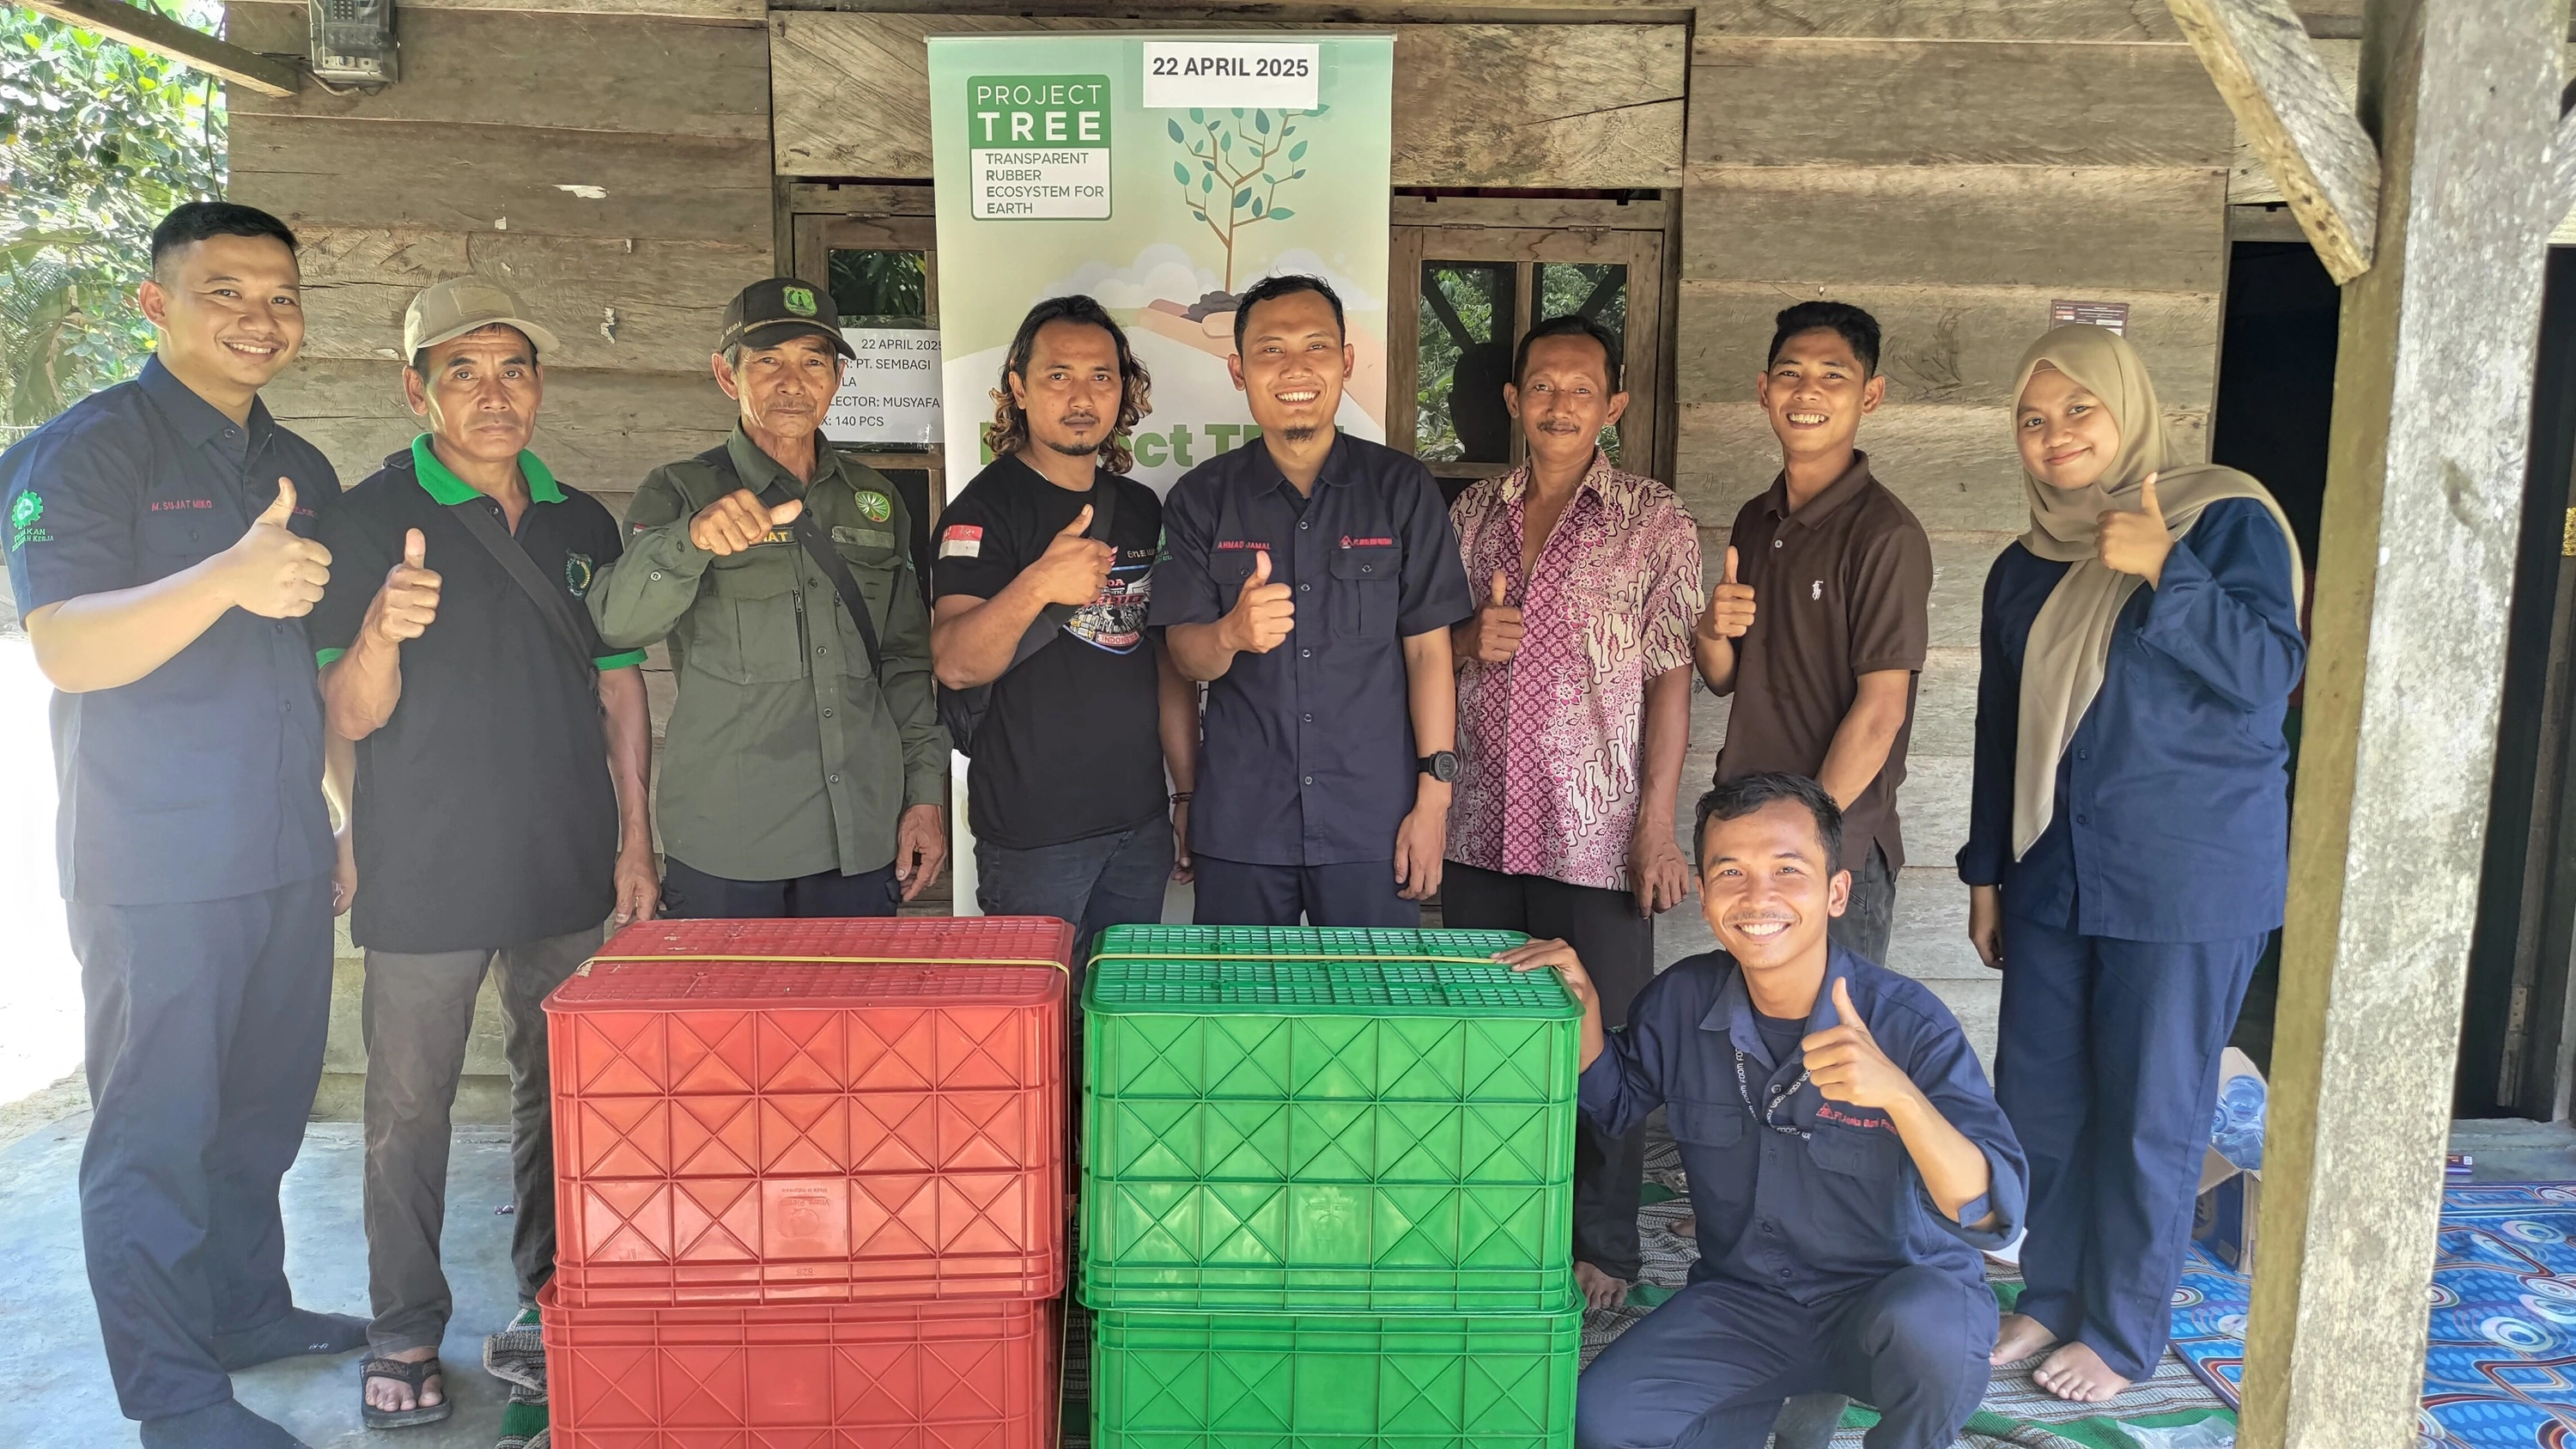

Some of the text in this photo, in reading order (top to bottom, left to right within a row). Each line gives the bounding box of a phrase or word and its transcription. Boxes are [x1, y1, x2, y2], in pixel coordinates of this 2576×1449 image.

[1152, 57, 1309, 77] 22 APRIL 2025
[977, 84, 1102, 106] PROJECT
[977, 111, 1101, 141] TREE
[985, 152, 1089, 165] TRANSPARENT
[986, 169, 1042, 181] RUBBER
[987, 186, 1104, 198] ECOSYSTEM FOR
[987, 203, 1033, 214] EARTH
[861, 339, 876, 350] 22
[878, 339, 913, 350] APRIL
[856, 359, 872, 369] PT.
[875, 359, 931, 370] SEMBAGI
[841, 377, 857, 387] LA
[829, 396, 940, 408] LECTOR: MUSYAFA
[835, 416, 856, 426] 140
[860, 416, 884, 427] PCS
[162, 500, 191, 510] SUJAT
[1218, 541, 1243, 550] AHMAD
[1101, 632, 1139, 643] INDONESIA
